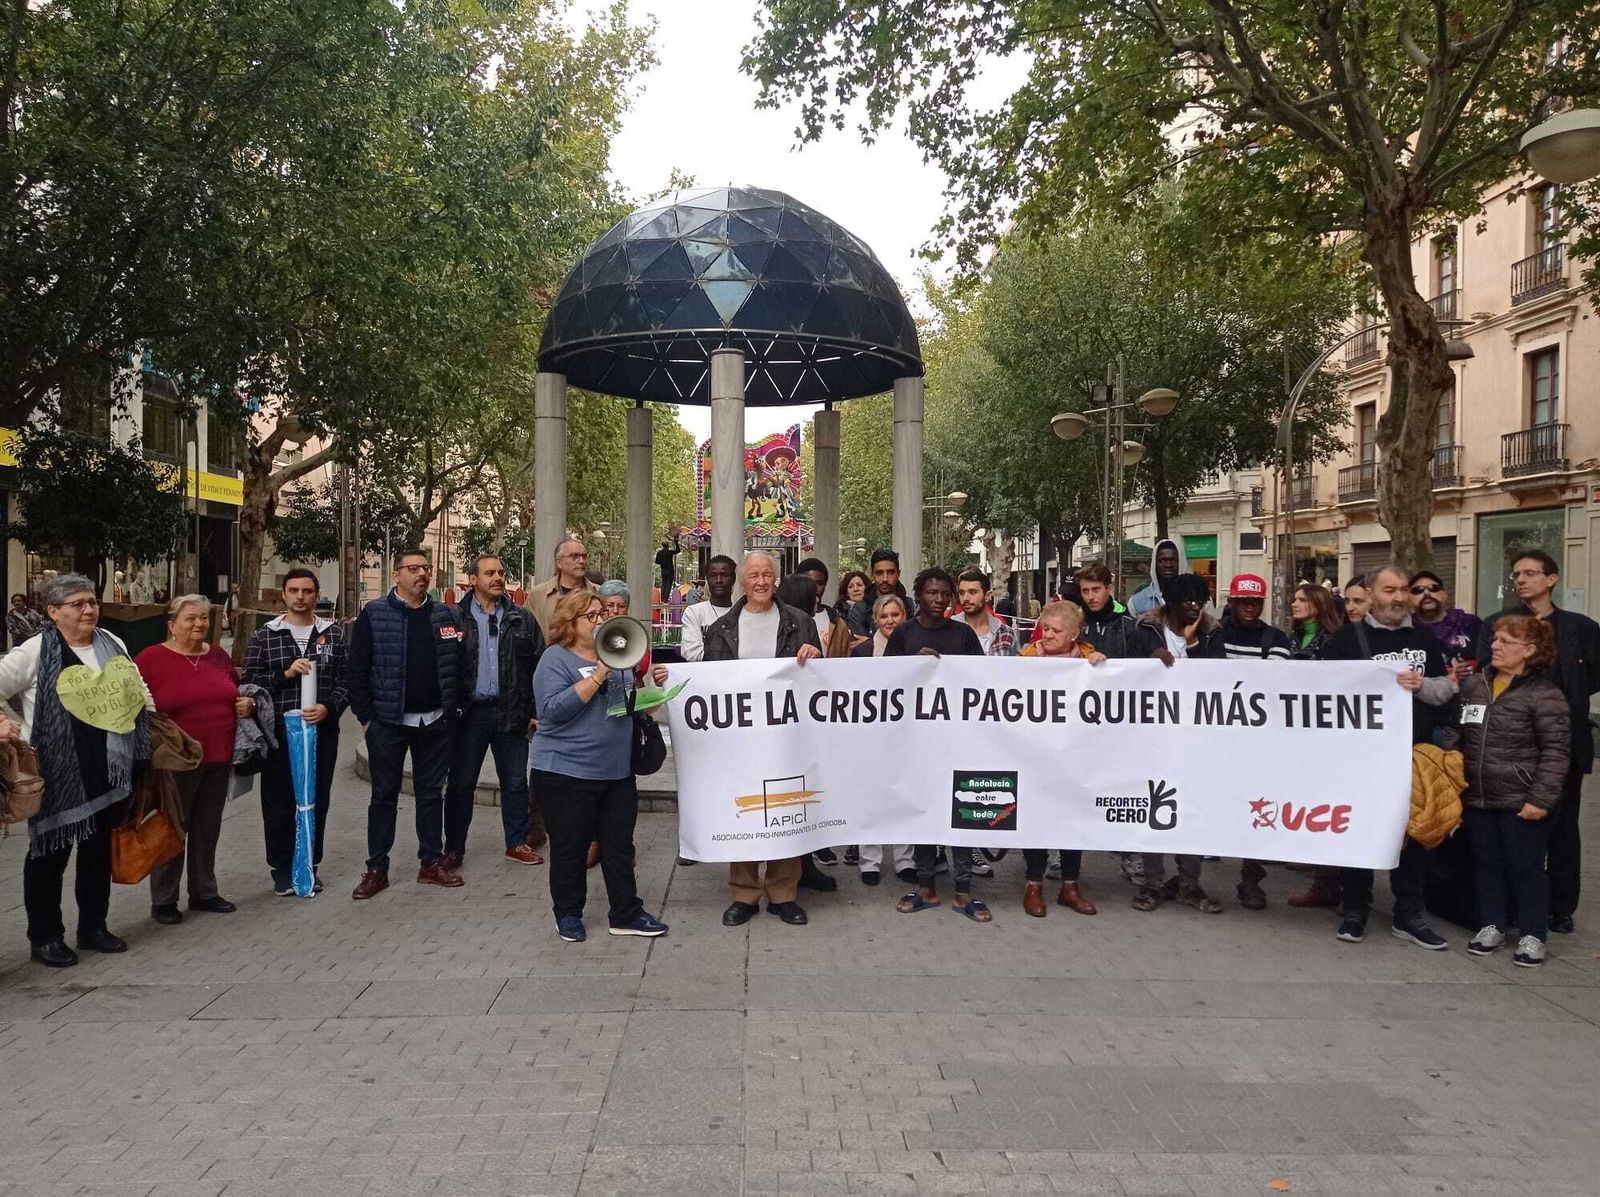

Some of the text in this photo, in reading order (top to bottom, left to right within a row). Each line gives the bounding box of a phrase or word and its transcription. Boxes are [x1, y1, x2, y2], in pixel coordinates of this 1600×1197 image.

[67, 673, 89, 687] POR
[76, 677, 136, 702] SERVICIOS
[86, 691, 144, 718] PUBLCOS
[684, 681, 1384, 731] QUE LA CRISIS LA PAGUE QUIEN MÁS TIENE
[975, 794, 996, 802] entre
[1095, 797, 1148, 808] RECORTES
[770, 813, 804, 828] APIC
[1105, 808, 1147, 824] CERO
[1282, 801, 1352, 834] UCE
[711, 833, 754, 841] ASOCIACION
[755, 825, 811, 839] PRO-INMIGRANTES
[818, 819, 847, 829] CORDOBA
